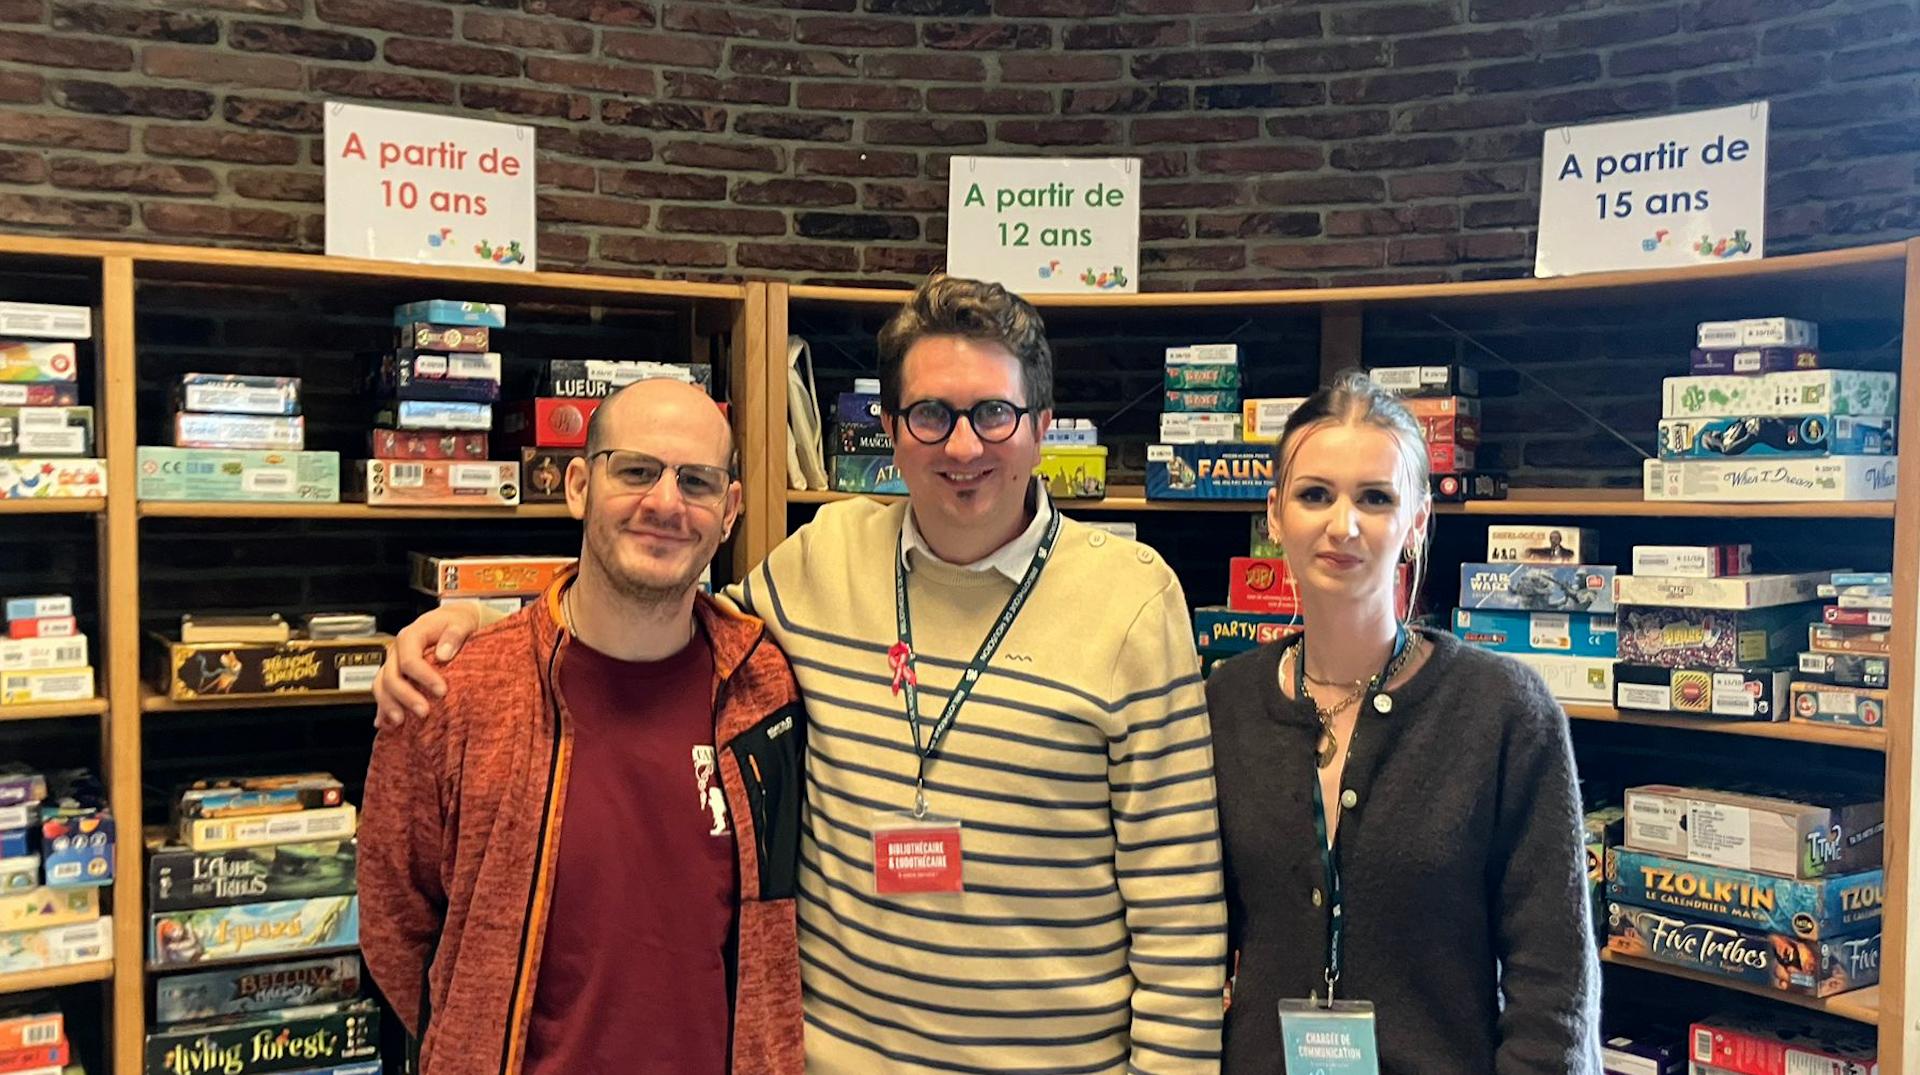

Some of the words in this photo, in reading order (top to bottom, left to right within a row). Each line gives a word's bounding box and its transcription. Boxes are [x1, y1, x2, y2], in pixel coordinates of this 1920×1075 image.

[342, 132, 366, 160] A
[380, 142, 467, 170] partir
[478, 148, 520, 176] de
[1558, 154, 1583, 181] A
[1596, 141, 1690, 183] partir
[1701, 135, 1749, 165] de
[381, 180, 418, 209] 10
[429, 191, 487, 216] ans
[964, 182, 985, 207] A
[997, 182, 1075, 213] partir
[1084, 182, 1124, 207] de
[1596, 191, 1632, 219] 15
[1645, 189, 1709, 215] ans
[998, 222, 1029, 246] 12
[1040, 227, 1092, 247] ans
[555, 379, 606, 397] LUEUR
[1198, 459, 1274, 480] FAUN
[1723, 466, 1758, 488] When
[1769, 466, 1815, 489] Dream
[1470, 579, 1509, 591] WARS
[1471, 572, 1510, 582] STAR
[1213, 620, 1257, 641] PARTY
[1640, 866, 1776, 912] TZOLK'IN
